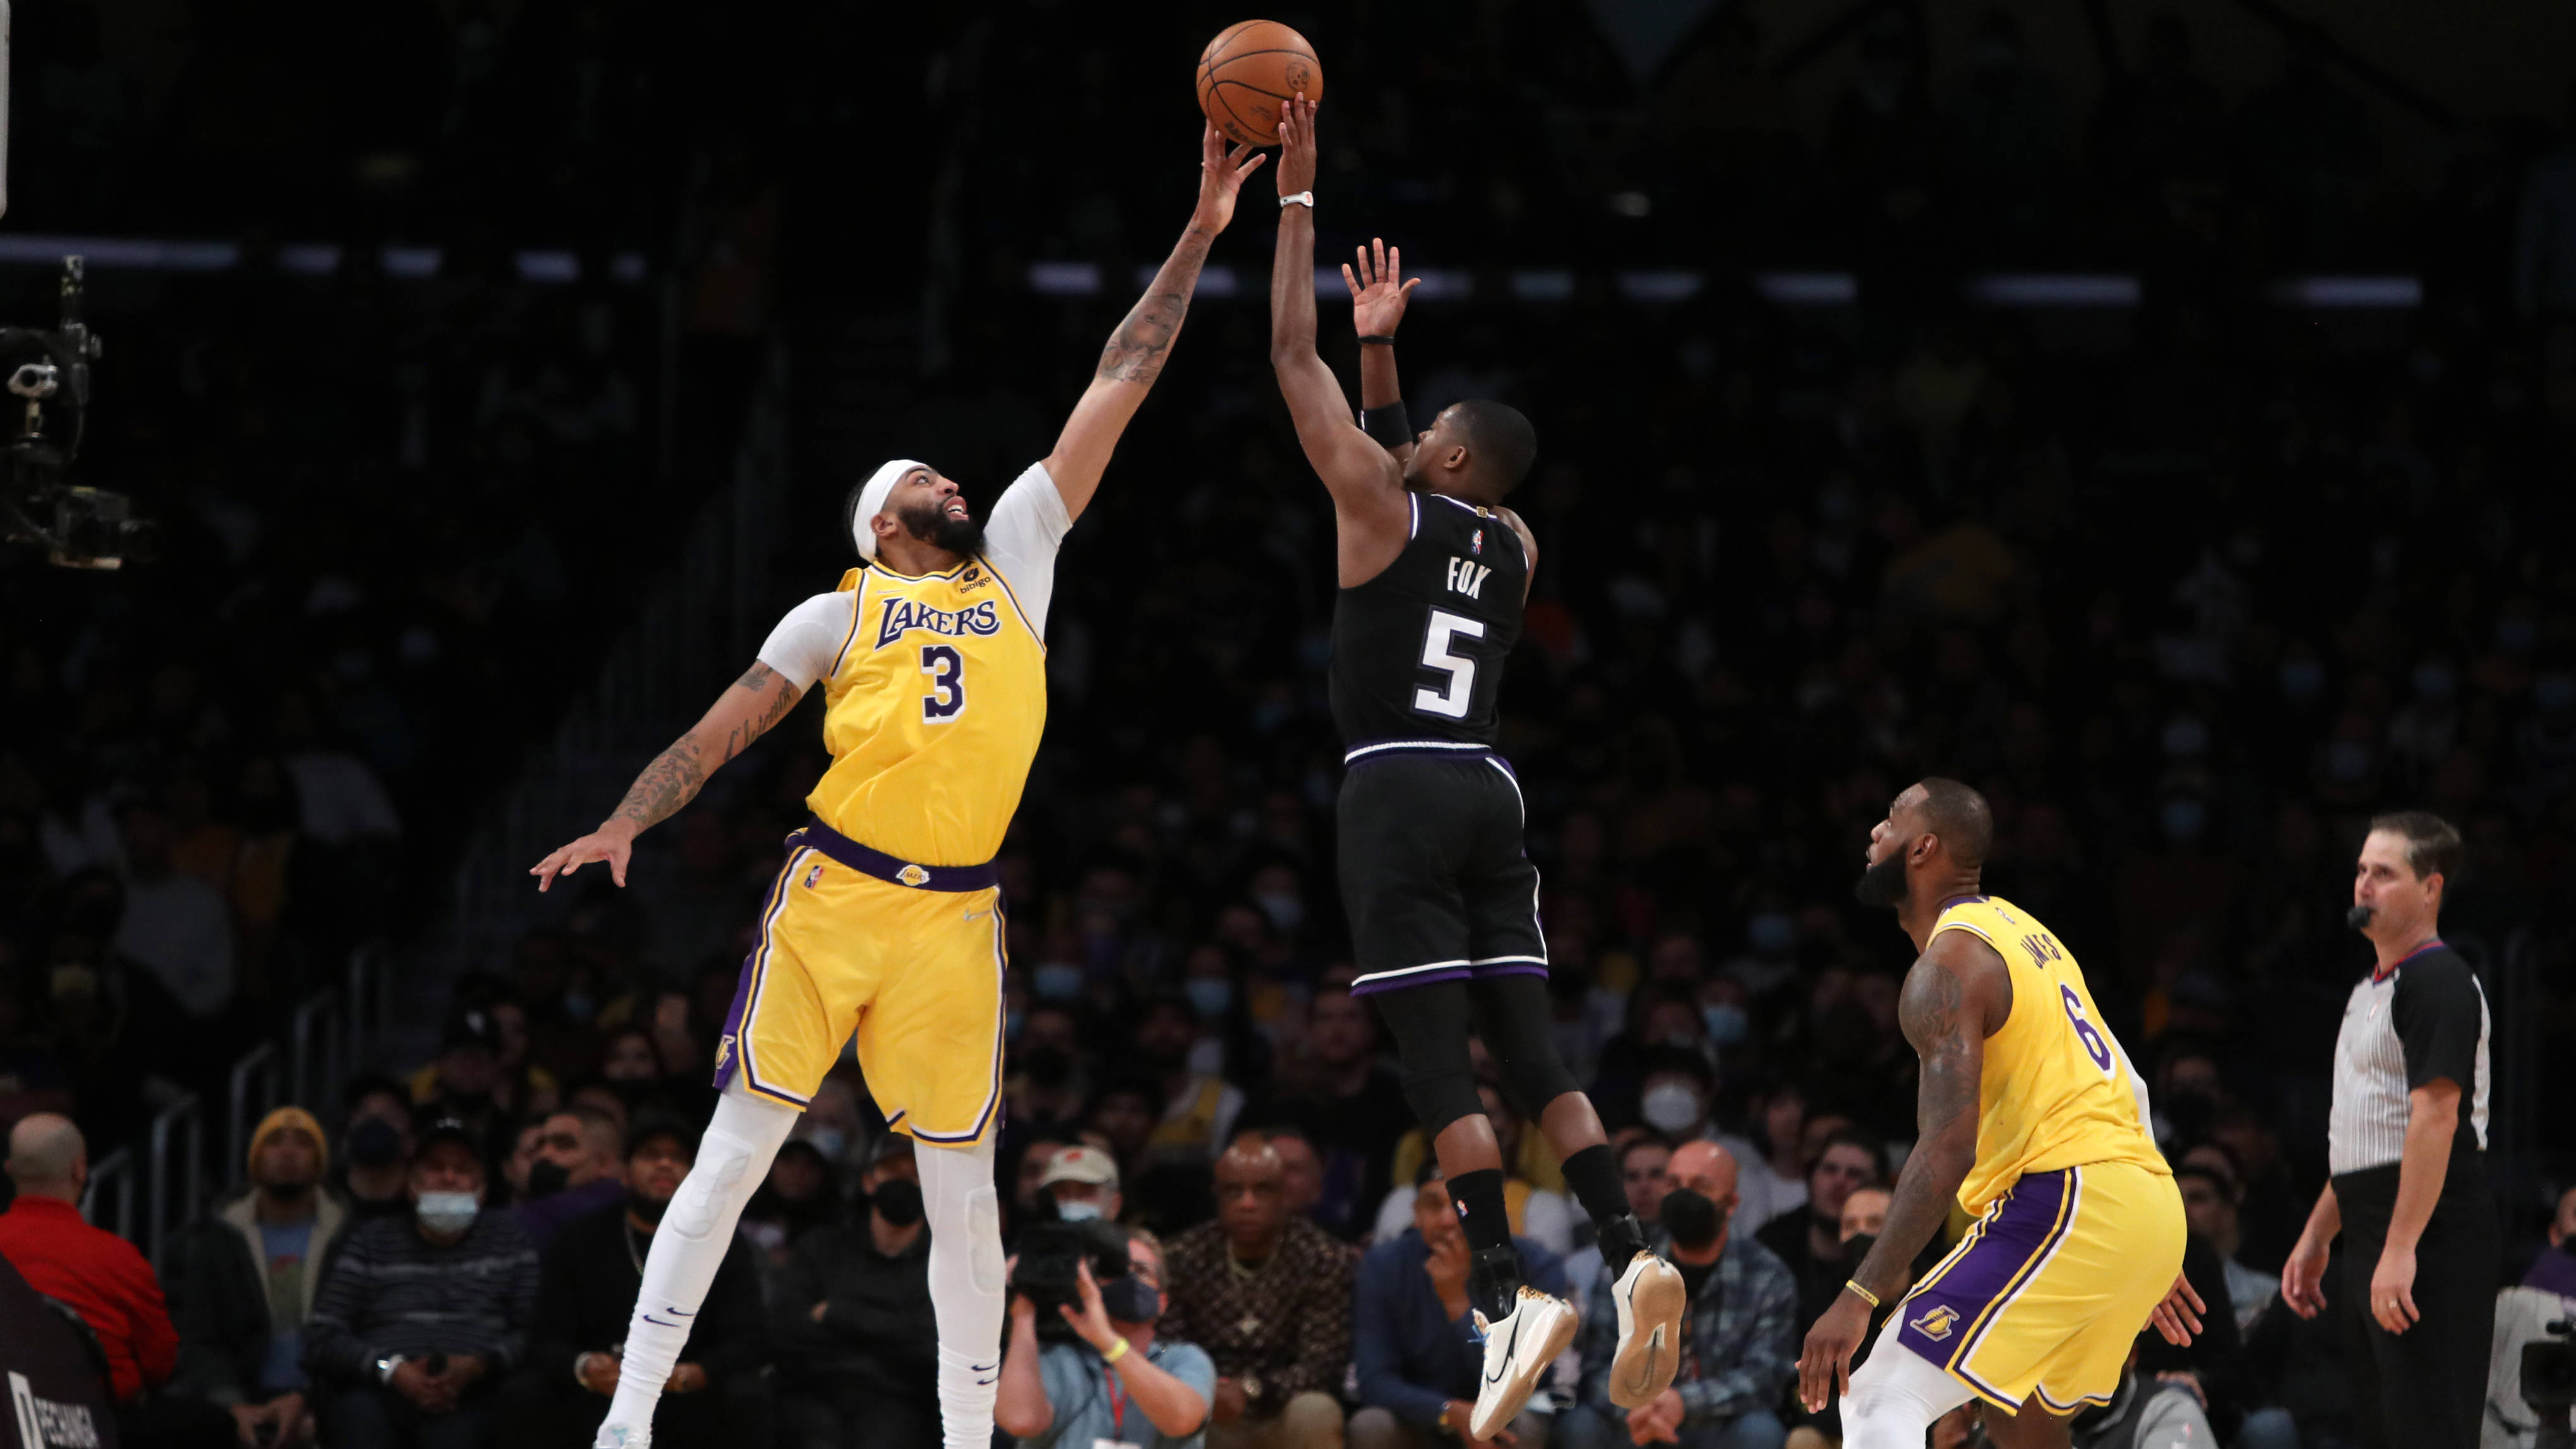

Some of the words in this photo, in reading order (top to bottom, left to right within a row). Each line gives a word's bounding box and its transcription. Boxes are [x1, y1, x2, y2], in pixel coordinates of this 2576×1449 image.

[960, 577, 991, 594] bibigo
[1447, 556, 1492, 600] FOX
[875, 597, 1000, 650] LAKERS
[920, 644, 965, 724] 3
[1412, 606, 1486, 720] 5
[2060, 982, 2115, 1077] 6
